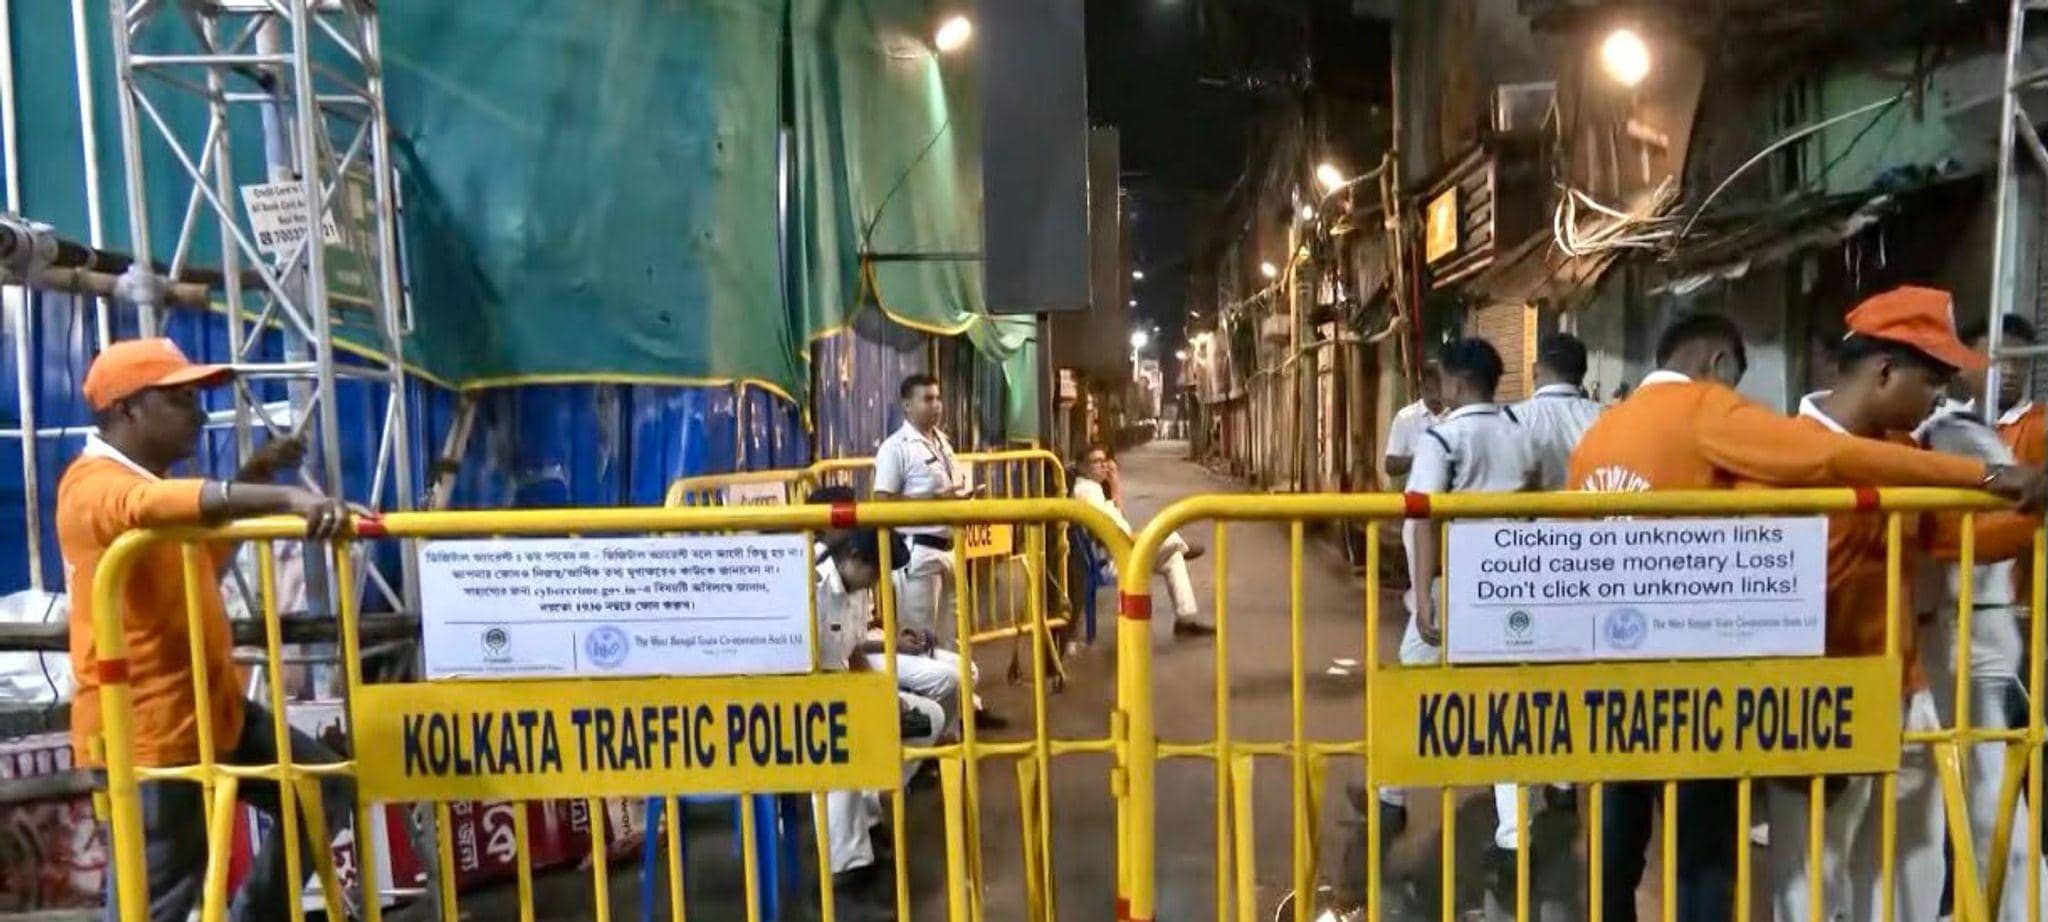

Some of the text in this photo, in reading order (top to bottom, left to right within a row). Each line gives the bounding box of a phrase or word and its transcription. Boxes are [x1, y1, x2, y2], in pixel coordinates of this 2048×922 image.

[1494, 524, 1783, 550] Clicking on unknown links
[1481, 550, 1795, 574] could cause monetary Loss!
[1477, 576, 1798, 600] Don't click on unknown links!
[1418, 685, 1854, 757] KOLKATA TRAFFIC POLICE
[404, 700, 850, 777] KOLKATA TRAFFIC POLICE
